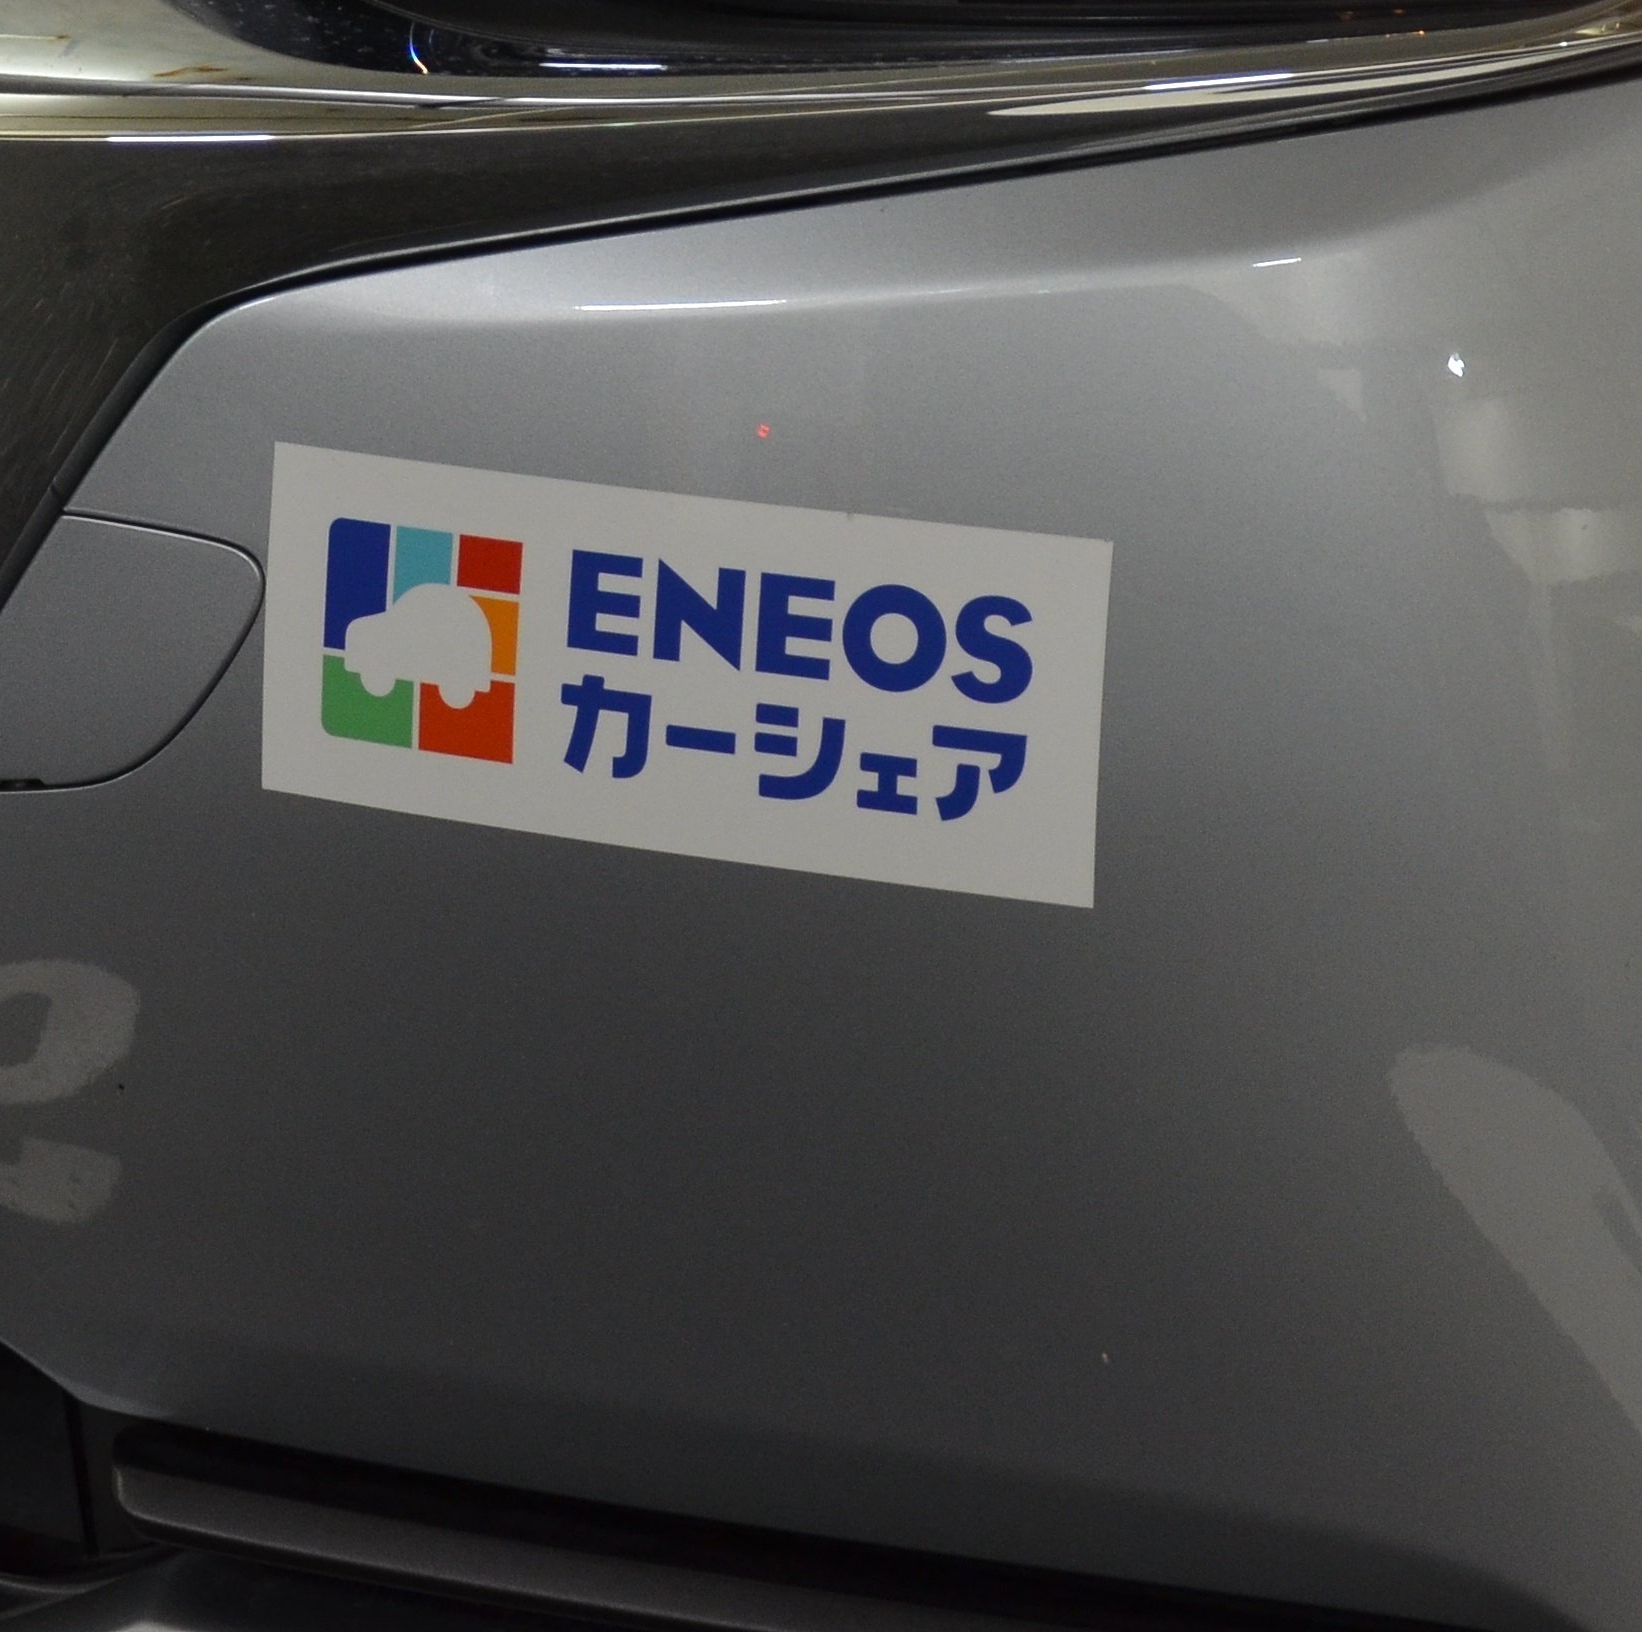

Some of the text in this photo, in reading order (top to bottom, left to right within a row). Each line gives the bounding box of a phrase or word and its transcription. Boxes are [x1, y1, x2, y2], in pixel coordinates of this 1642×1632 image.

[567, 550, 1034, 705] ENEOS
[560, 674, 1028, 821] カーシェア
